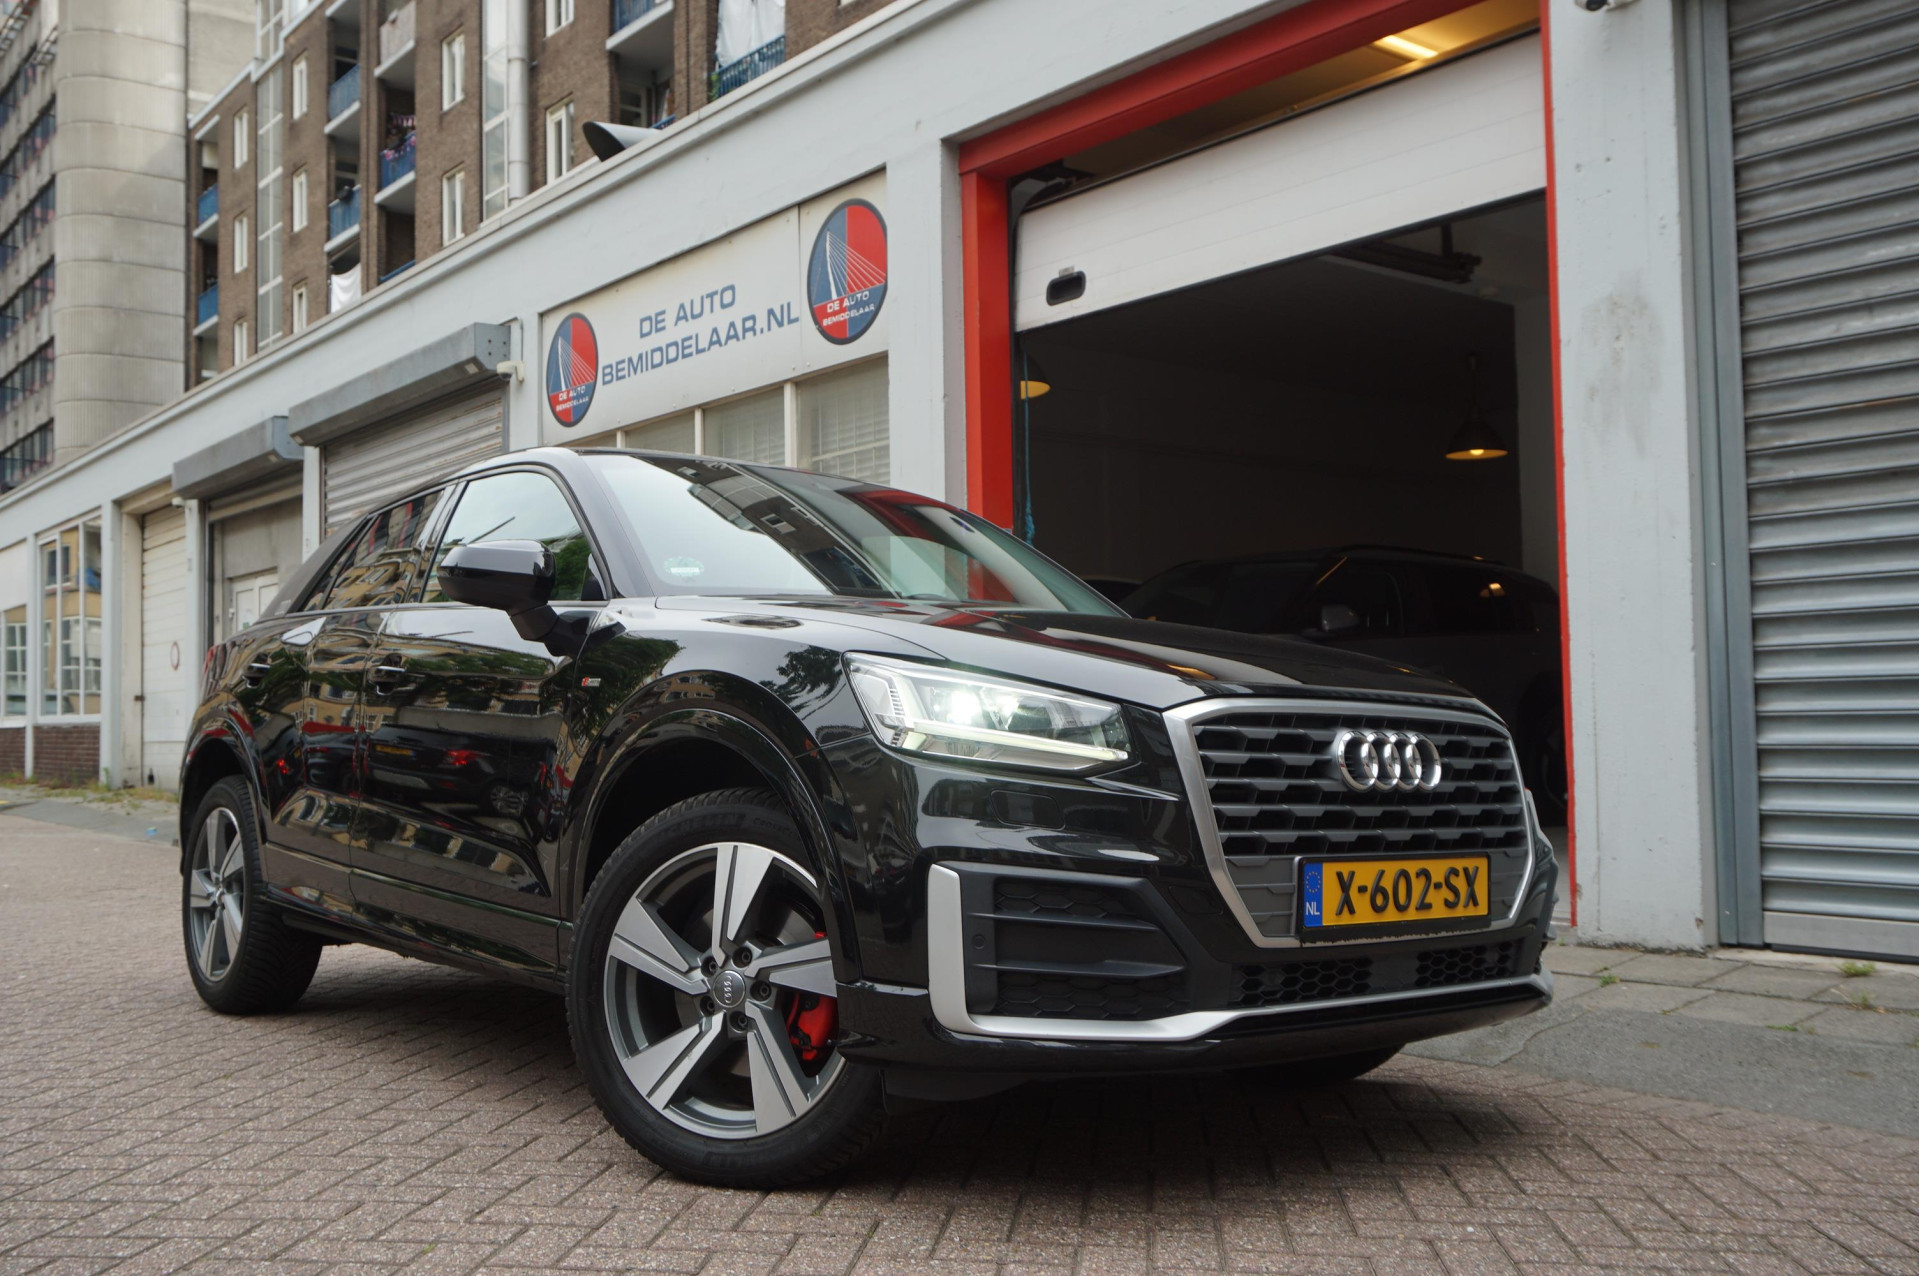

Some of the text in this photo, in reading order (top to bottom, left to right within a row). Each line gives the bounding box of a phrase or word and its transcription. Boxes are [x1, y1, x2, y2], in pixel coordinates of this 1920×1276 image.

[639, 284, 736, 339] DE AUTO
[826, 291, 870, 313] DE AUTO
[602, 301, 800, 386] BEMIDDELAAR.NL
[558, 385, 586, 402] DE AUTO
[1305, 901, 1321, 916] NL
[1335, 865, 1479, 917] X-602-SX
